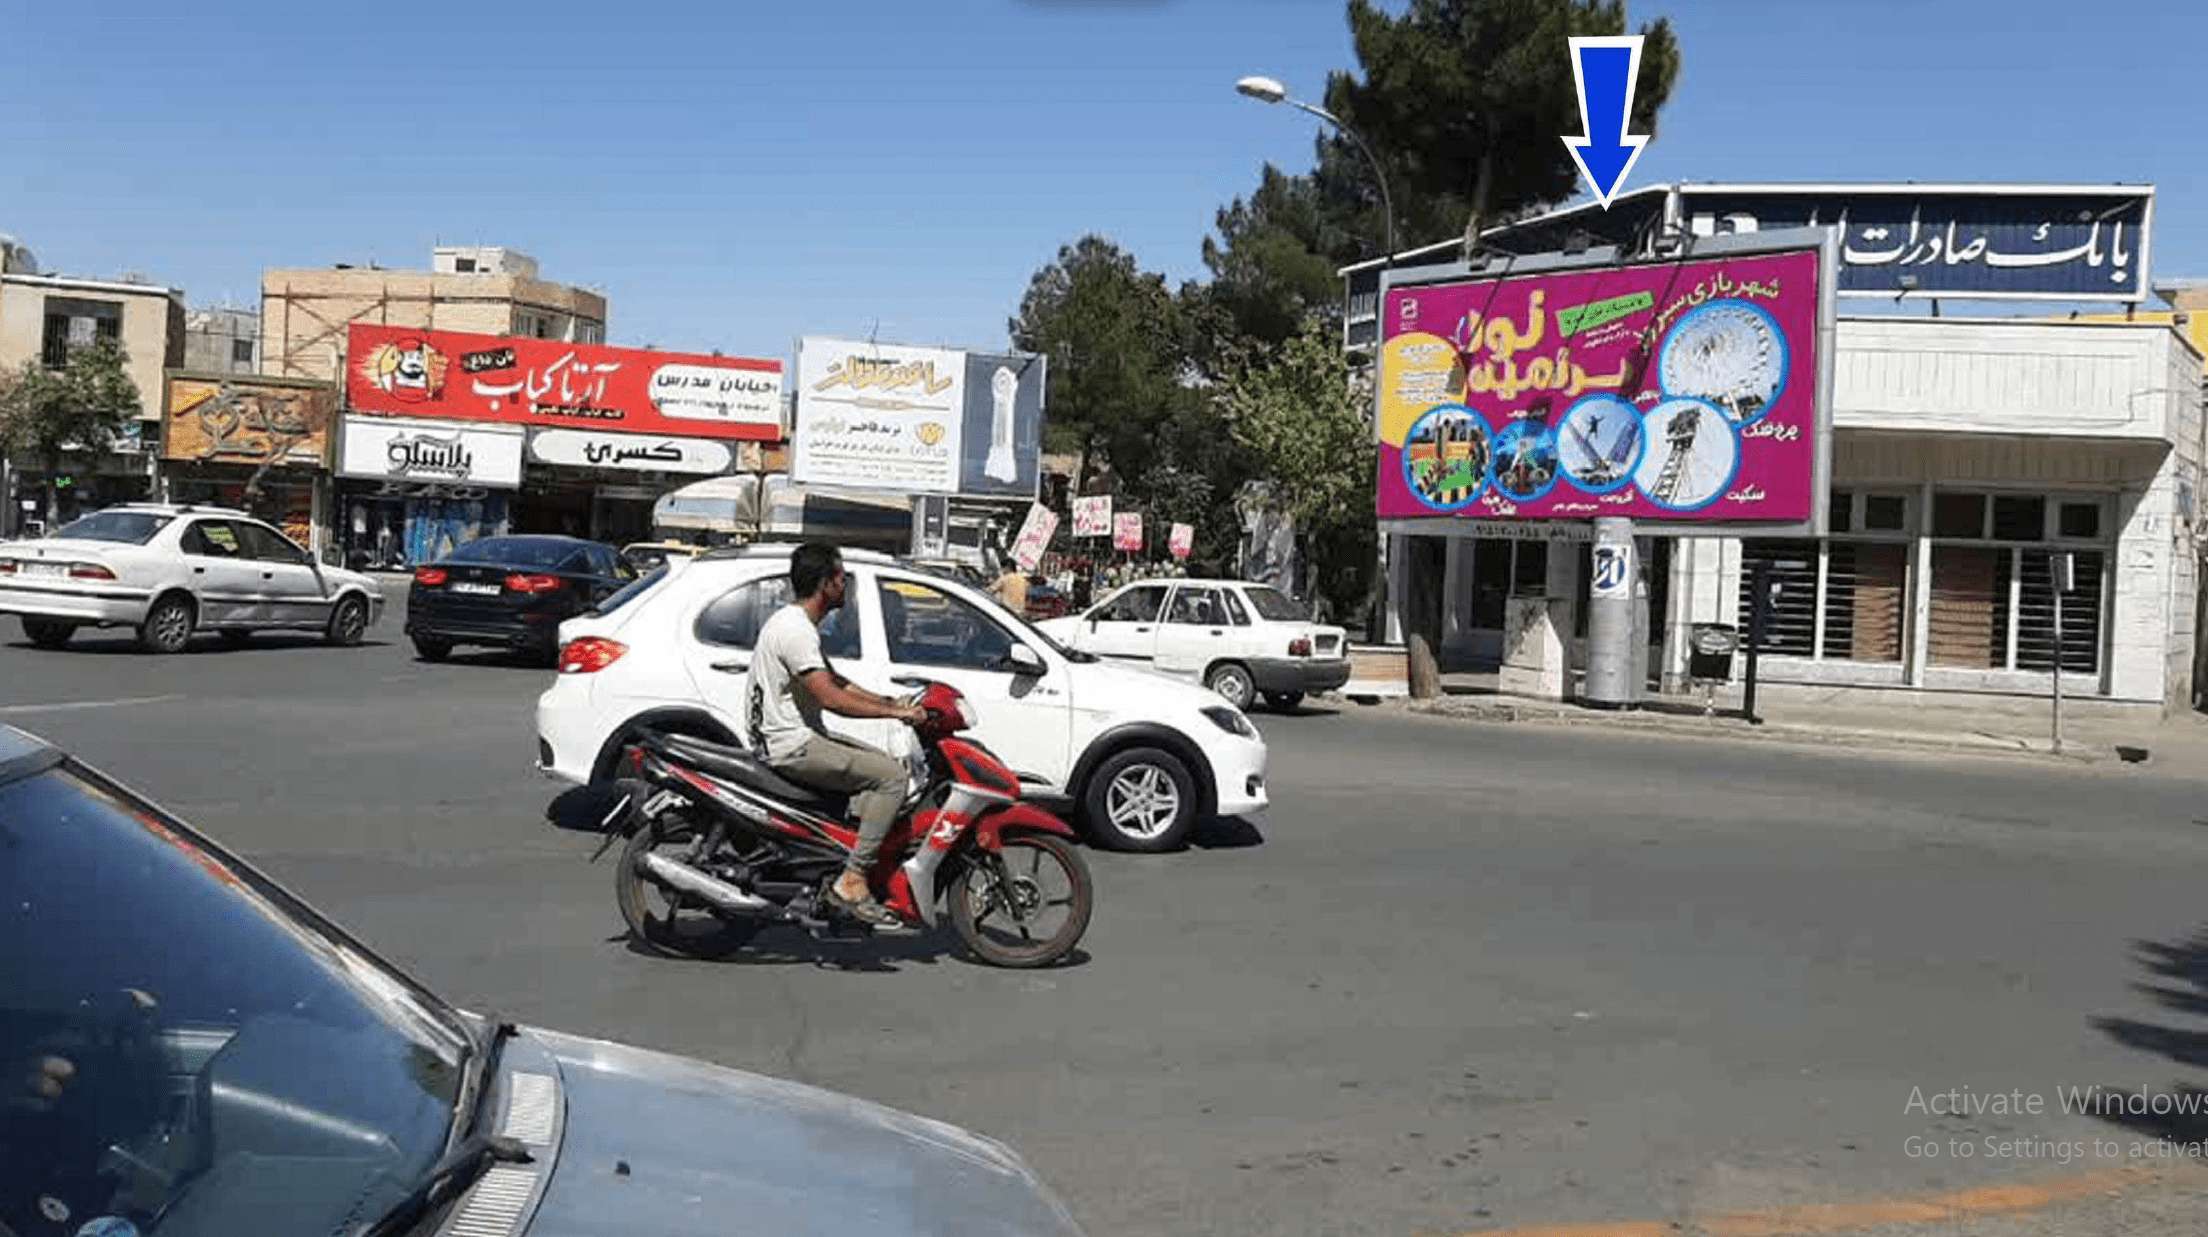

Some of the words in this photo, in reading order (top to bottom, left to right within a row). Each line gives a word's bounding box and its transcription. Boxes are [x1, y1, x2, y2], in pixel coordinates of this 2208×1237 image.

[1845, 204, 1987, 266] صادرات
[472, 351, 576, 414] کباب
[656, 374, 712, 389] مدرس
[719, 377, 773, 394] خیابان
